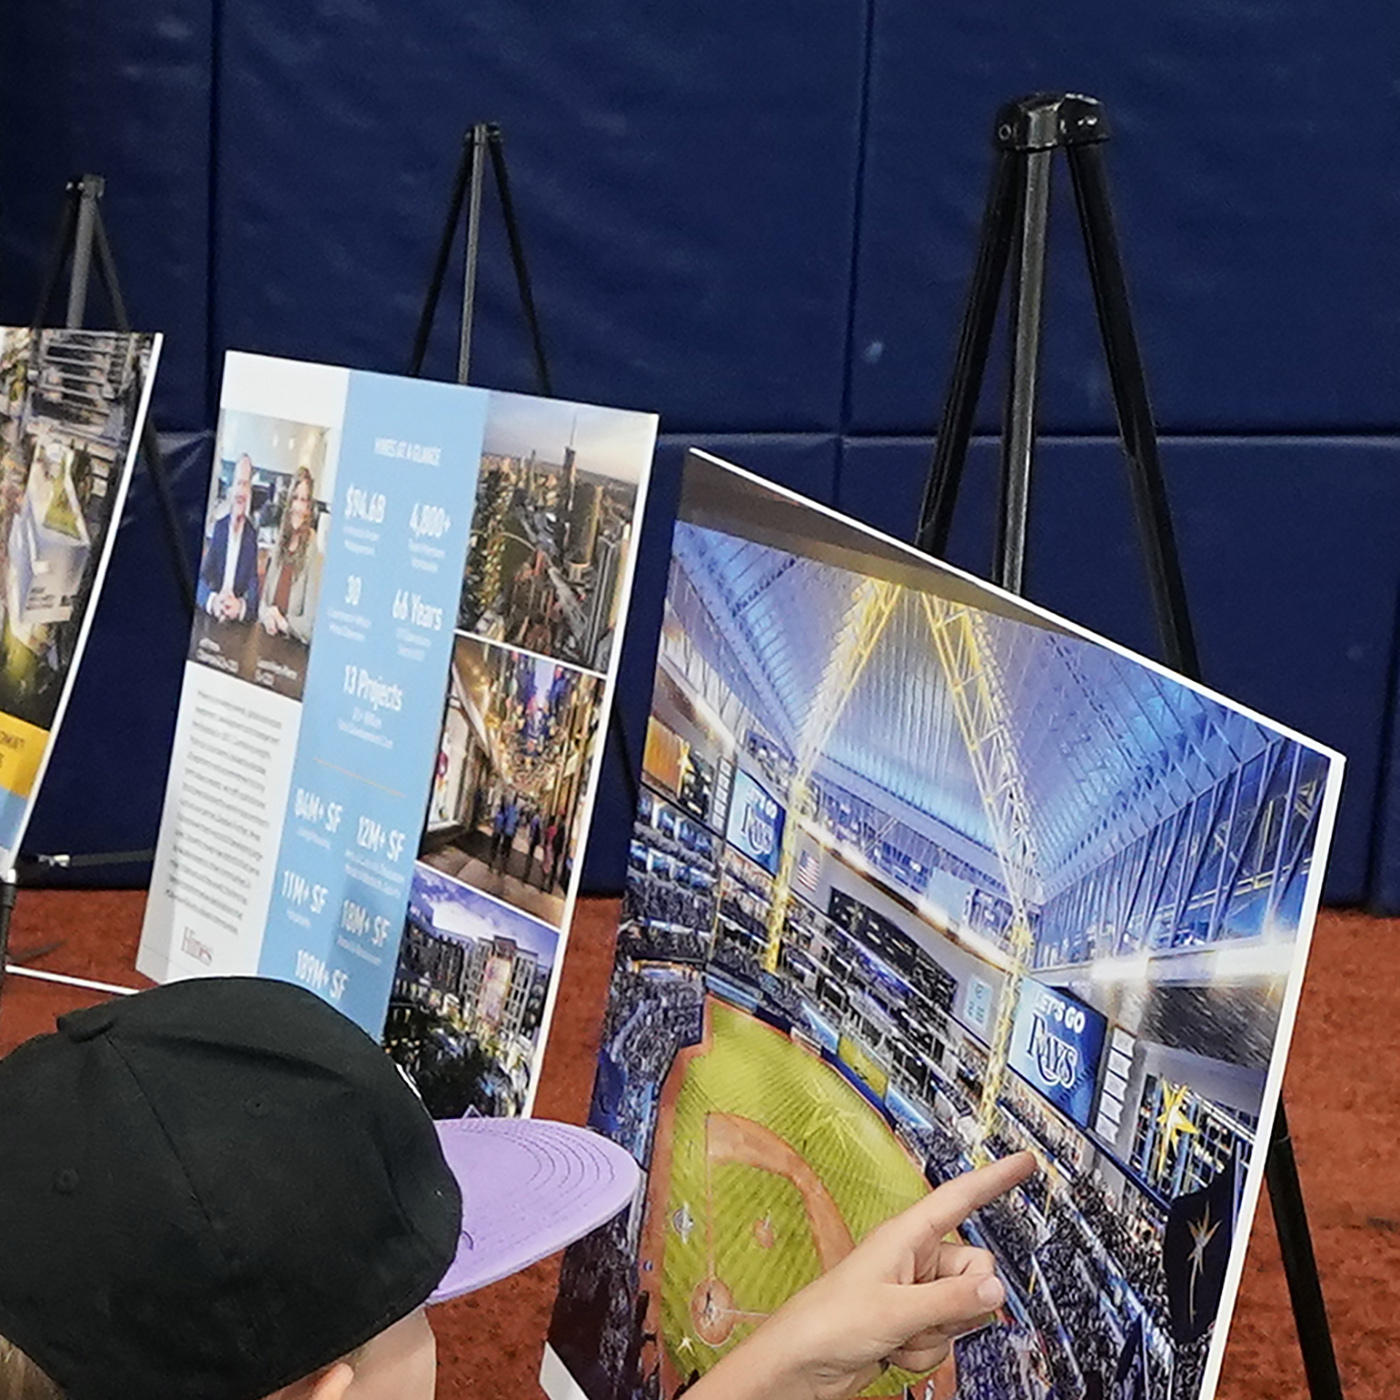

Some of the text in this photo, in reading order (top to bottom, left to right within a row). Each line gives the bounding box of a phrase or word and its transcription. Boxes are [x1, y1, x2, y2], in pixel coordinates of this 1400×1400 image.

[410, 592, 443, 631] Years
[343, 664, 357, 695] 13
[357, 668, 403, 712] Projects
[325, 801, 344, 833] SF
[386, 829, 406, 862] SF
[310, 884, 329, 914] SF
[371, 915, 391, 947] SF
[329, 968, 349, 1001] SF
[1064, 1005, 1086, 1034] GO
